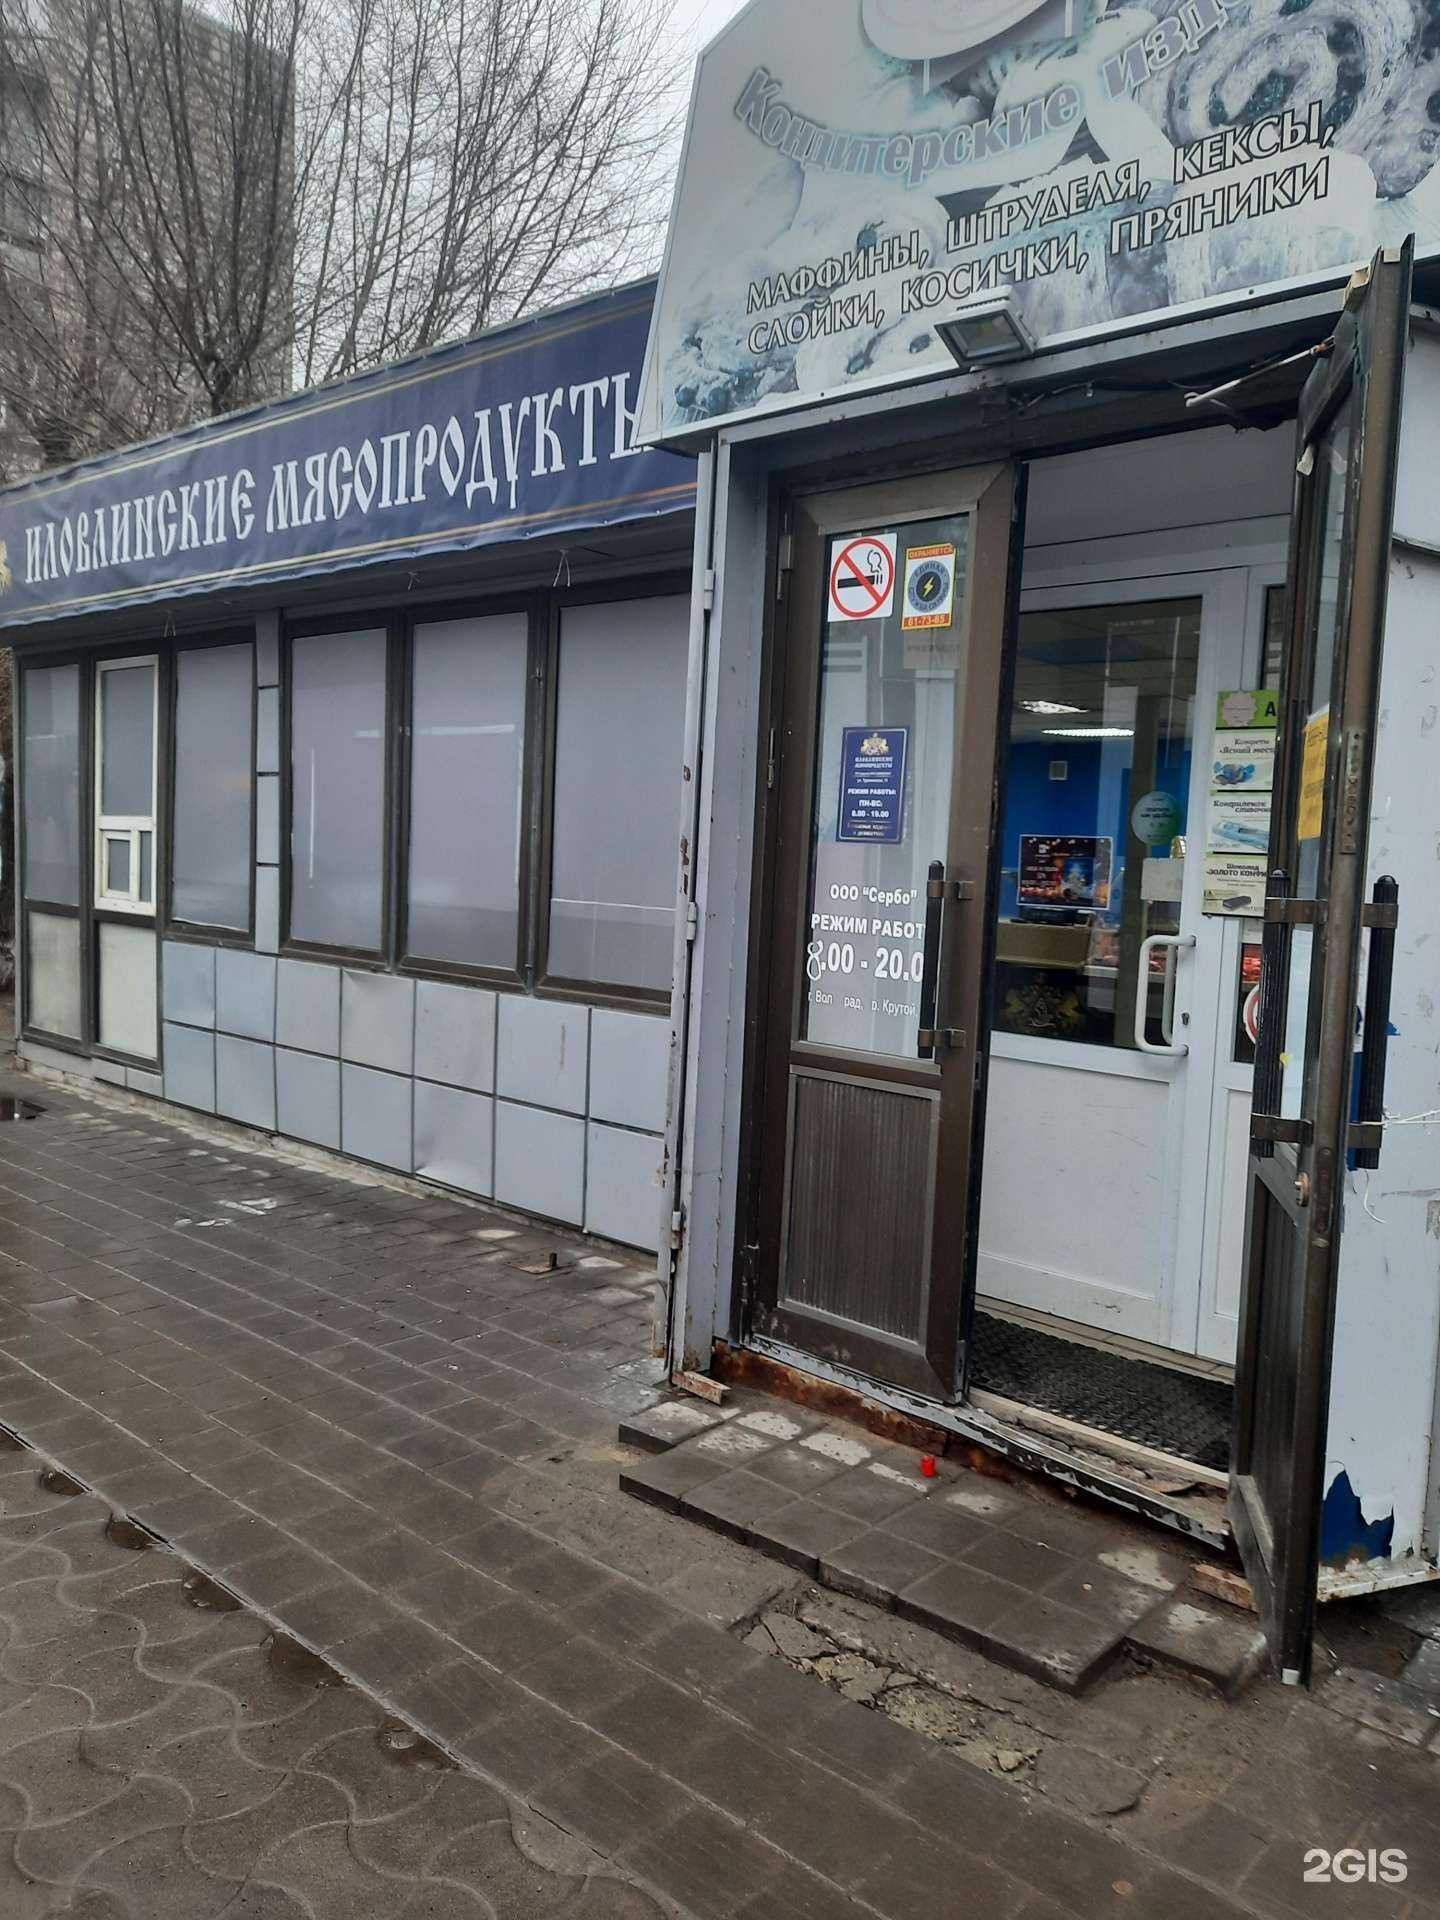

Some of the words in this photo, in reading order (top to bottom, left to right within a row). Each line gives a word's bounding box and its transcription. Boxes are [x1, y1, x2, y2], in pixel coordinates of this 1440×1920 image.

[735, 64, 1081, 188] Кондитерские
[1102, 0, 1240, 99] изд
[747, 230, 929, 314] МАФФИНЫ,
[945, 160, 1152, 253] ШТРУДЕЛЯ,
[1172, 99, 1336, 184] КЕКСЫ,
[748, 289, 884, 354] СЛОЙКИ,
[900, 232, 1089, 315] КОСИЧКИ,
[1109, 157, 1331, 256] ПРЯНИКИ
[24, 468, 256, 585] ИЛОВЛИНСКИЕ
[811, 913, 868, 935] РЕЖИМ
[871, 918, 926, 940] РАБОТ
[830, 884, 859, 901] ООО
[807, 940, 855, 981] 8.00
[874, 947, 925, 983] 20.0
